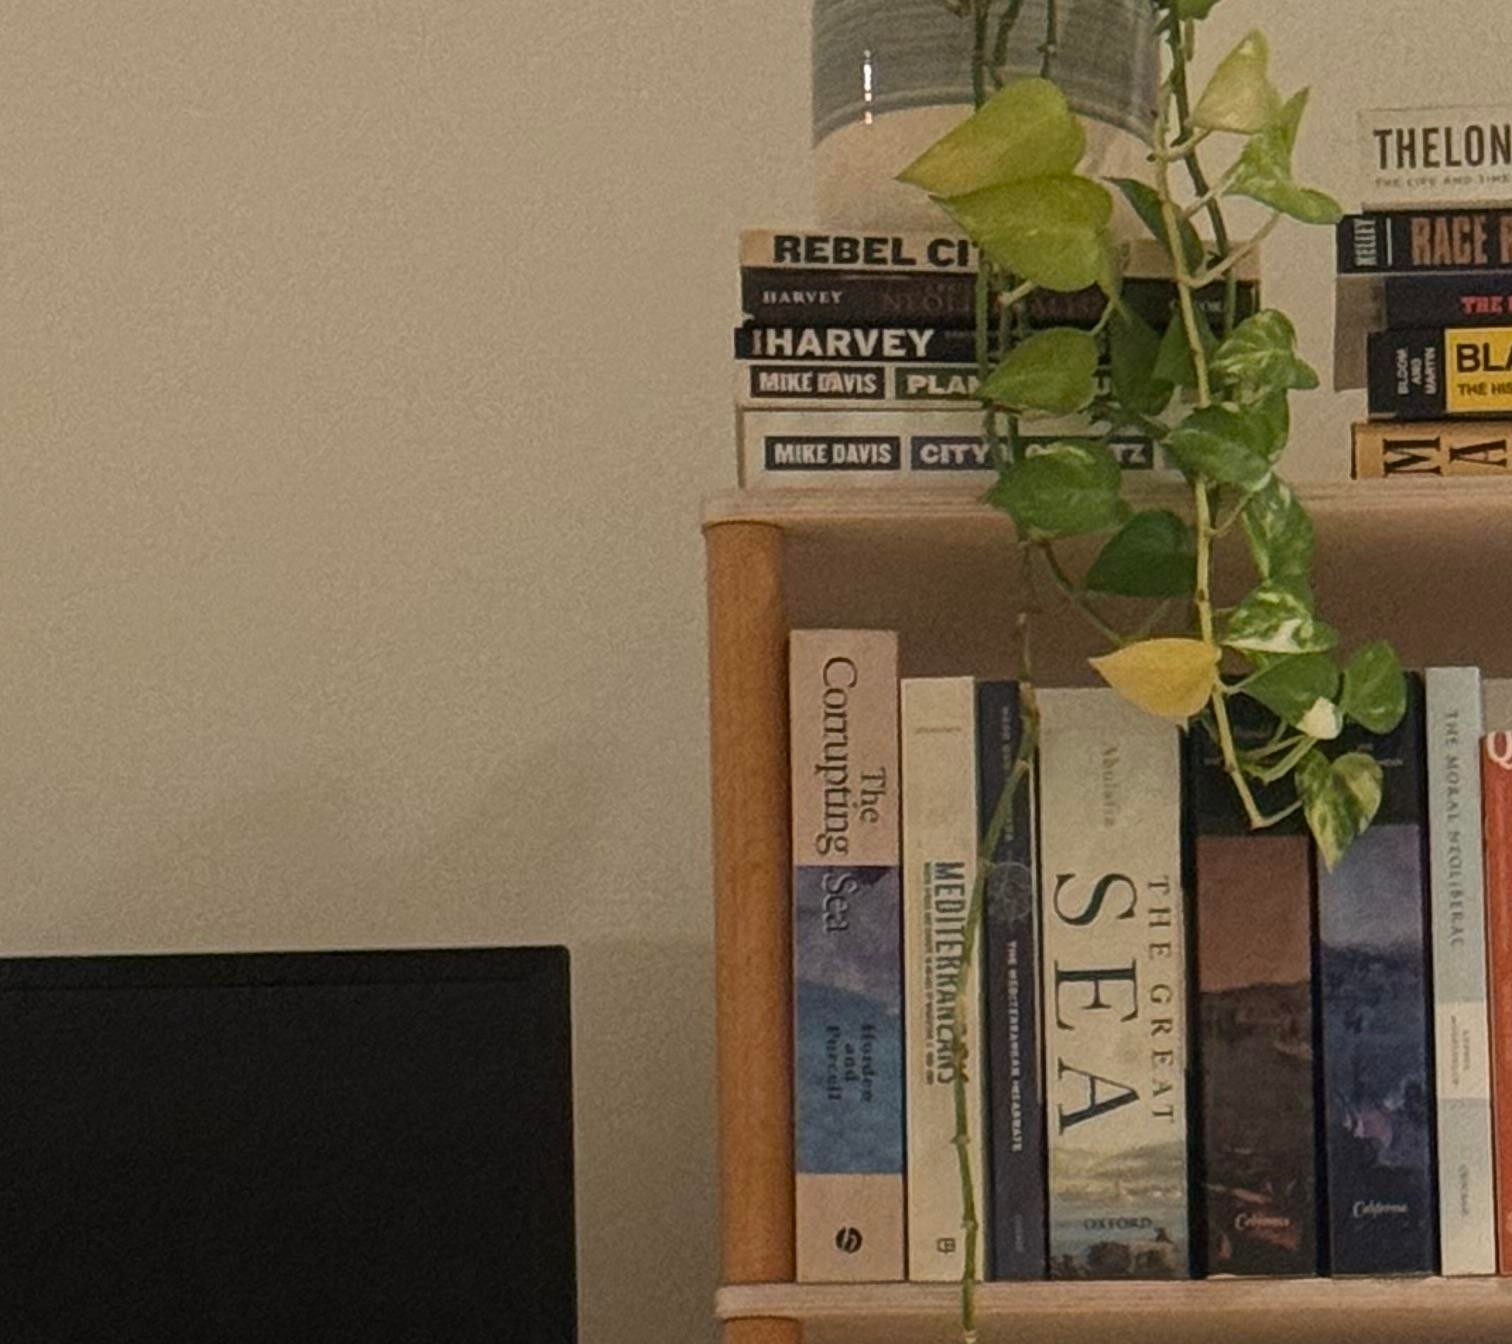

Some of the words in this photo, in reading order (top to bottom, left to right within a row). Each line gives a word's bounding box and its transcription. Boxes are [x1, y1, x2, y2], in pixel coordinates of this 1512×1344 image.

[774, 235, 916, 266] REBEL
[1410, 216, 1486, 265] RACE
[766, 329, 934, 357] HARVEY
[759, 372, 813, 394] MIKE
[817, 372, 877, 395] DAVIS
[774, 443, 828, 465] MIKE
[833, 443, 892, 466] DAVIS
[817, 657, 856, 854] Corrupting
[861, 768, 886, 824] The
[822, 873, 853, 933] Sea
[1147, 876, 1172, 959] THE
[1056, 873, 1140, 1136] SEA
[1150, 984, 1175, 1125] GREAT
